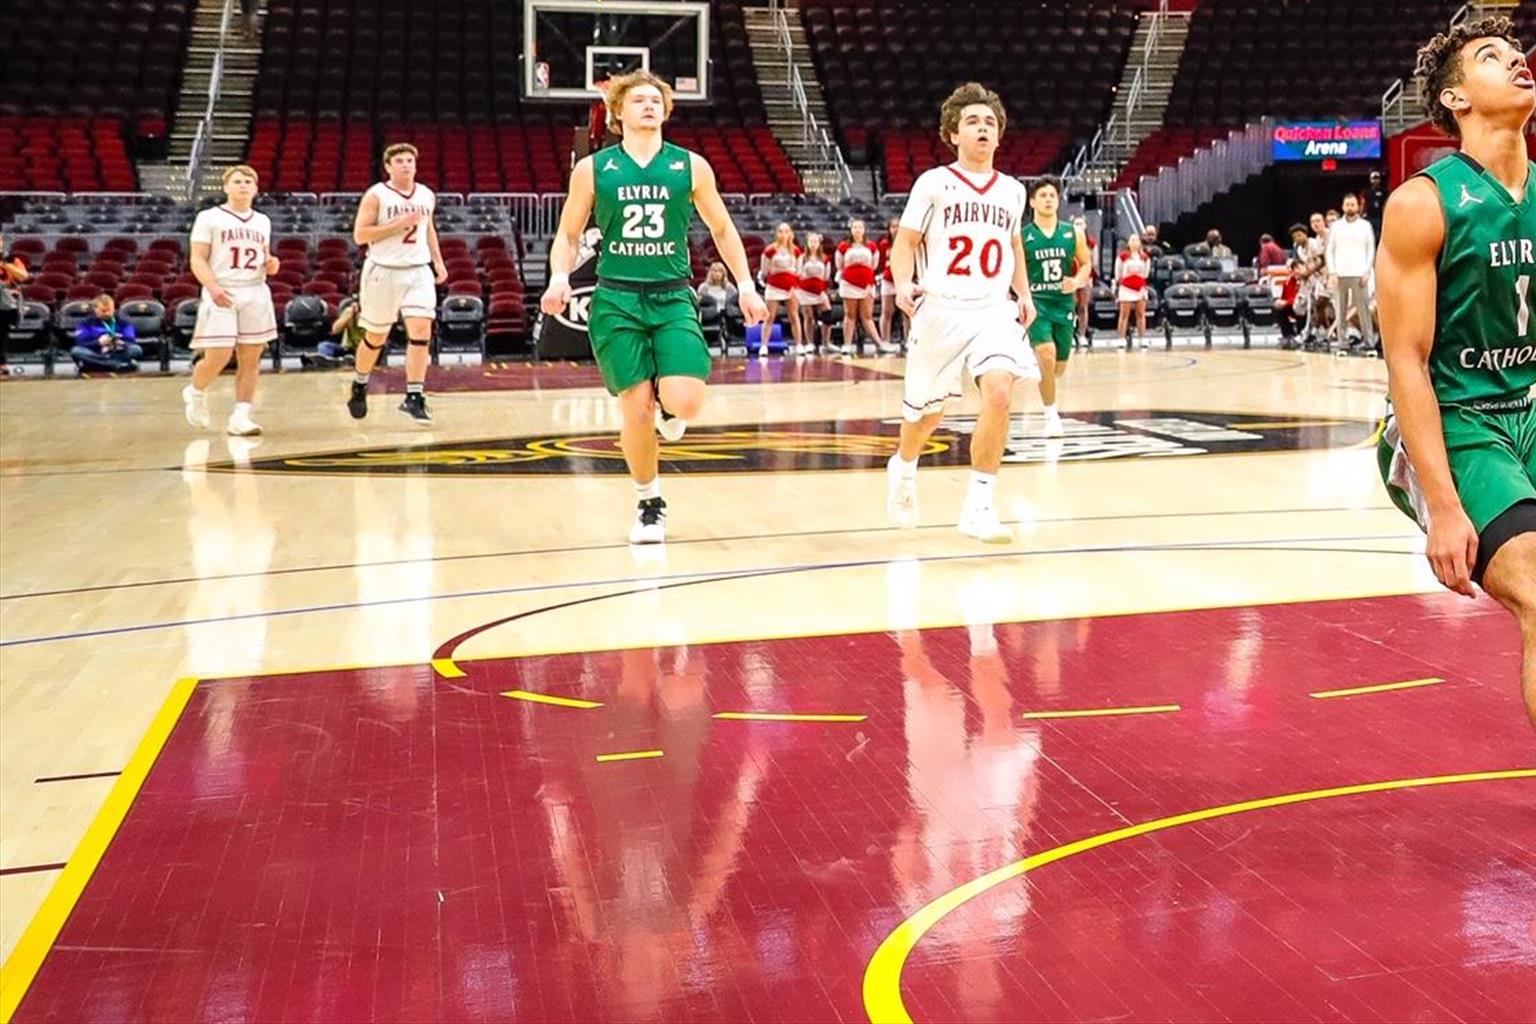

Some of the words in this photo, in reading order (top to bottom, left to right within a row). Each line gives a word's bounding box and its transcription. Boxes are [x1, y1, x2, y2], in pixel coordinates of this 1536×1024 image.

[1304, 140, 1348, 156] Arena
[617, 184, 670, 202] ELYRIA
[621, 203, 666, 239] 23
[402, 224, 418, 245] 2
[229, 246, 258, 270] 12
[608, 240, 676, 257] CATHOLIC
[946, 234, 1004, 279] 20
[1034, 247, 1067, 261] ELYRIA
[1041, 259, 1063, 283] 13
[1514, 274, 1531, 338] 1
